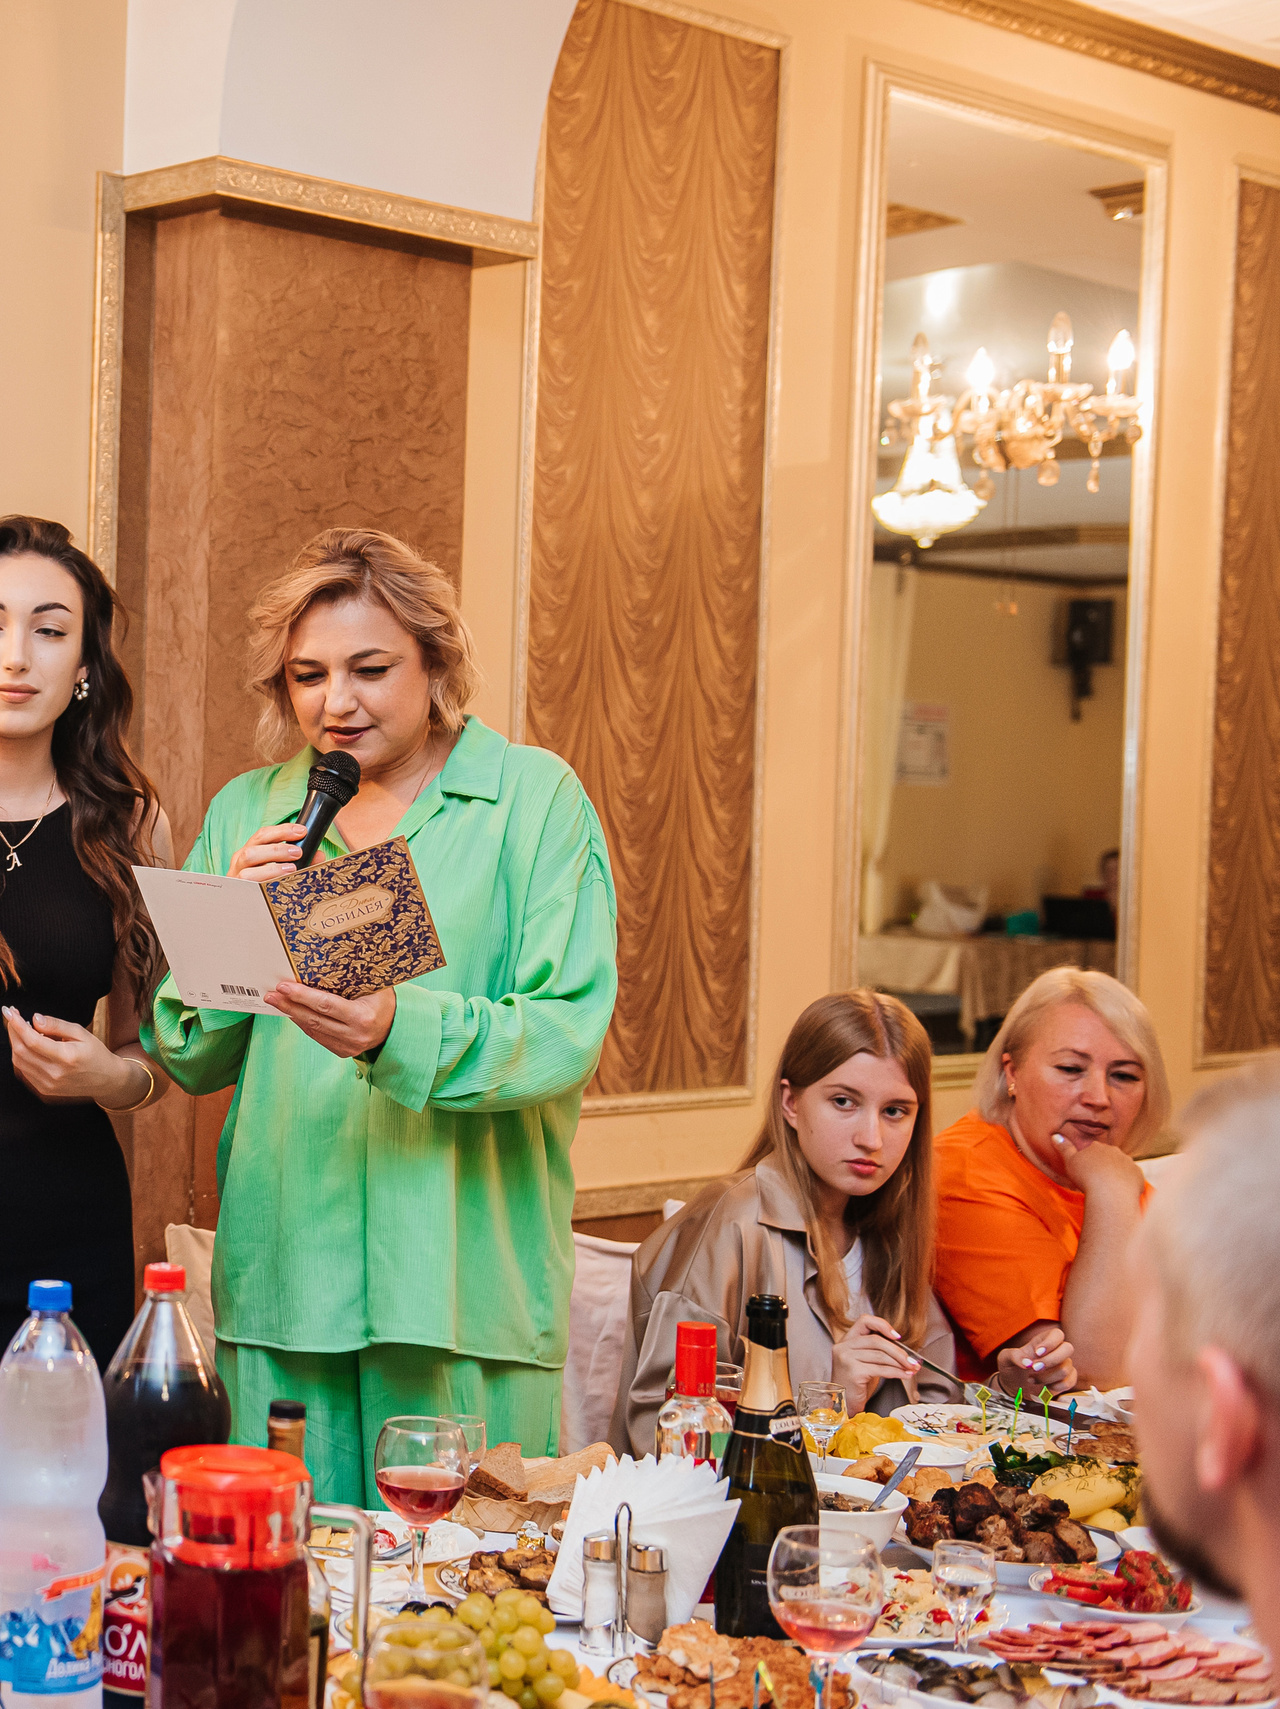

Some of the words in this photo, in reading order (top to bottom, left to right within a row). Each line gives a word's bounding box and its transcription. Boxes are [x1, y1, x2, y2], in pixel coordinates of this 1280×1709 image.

[321, 900, 383, 929] ЮБИЛЕЯ
[322, 904, 336, 917] С
[105, 1623, 148, 1661] ОЛ
